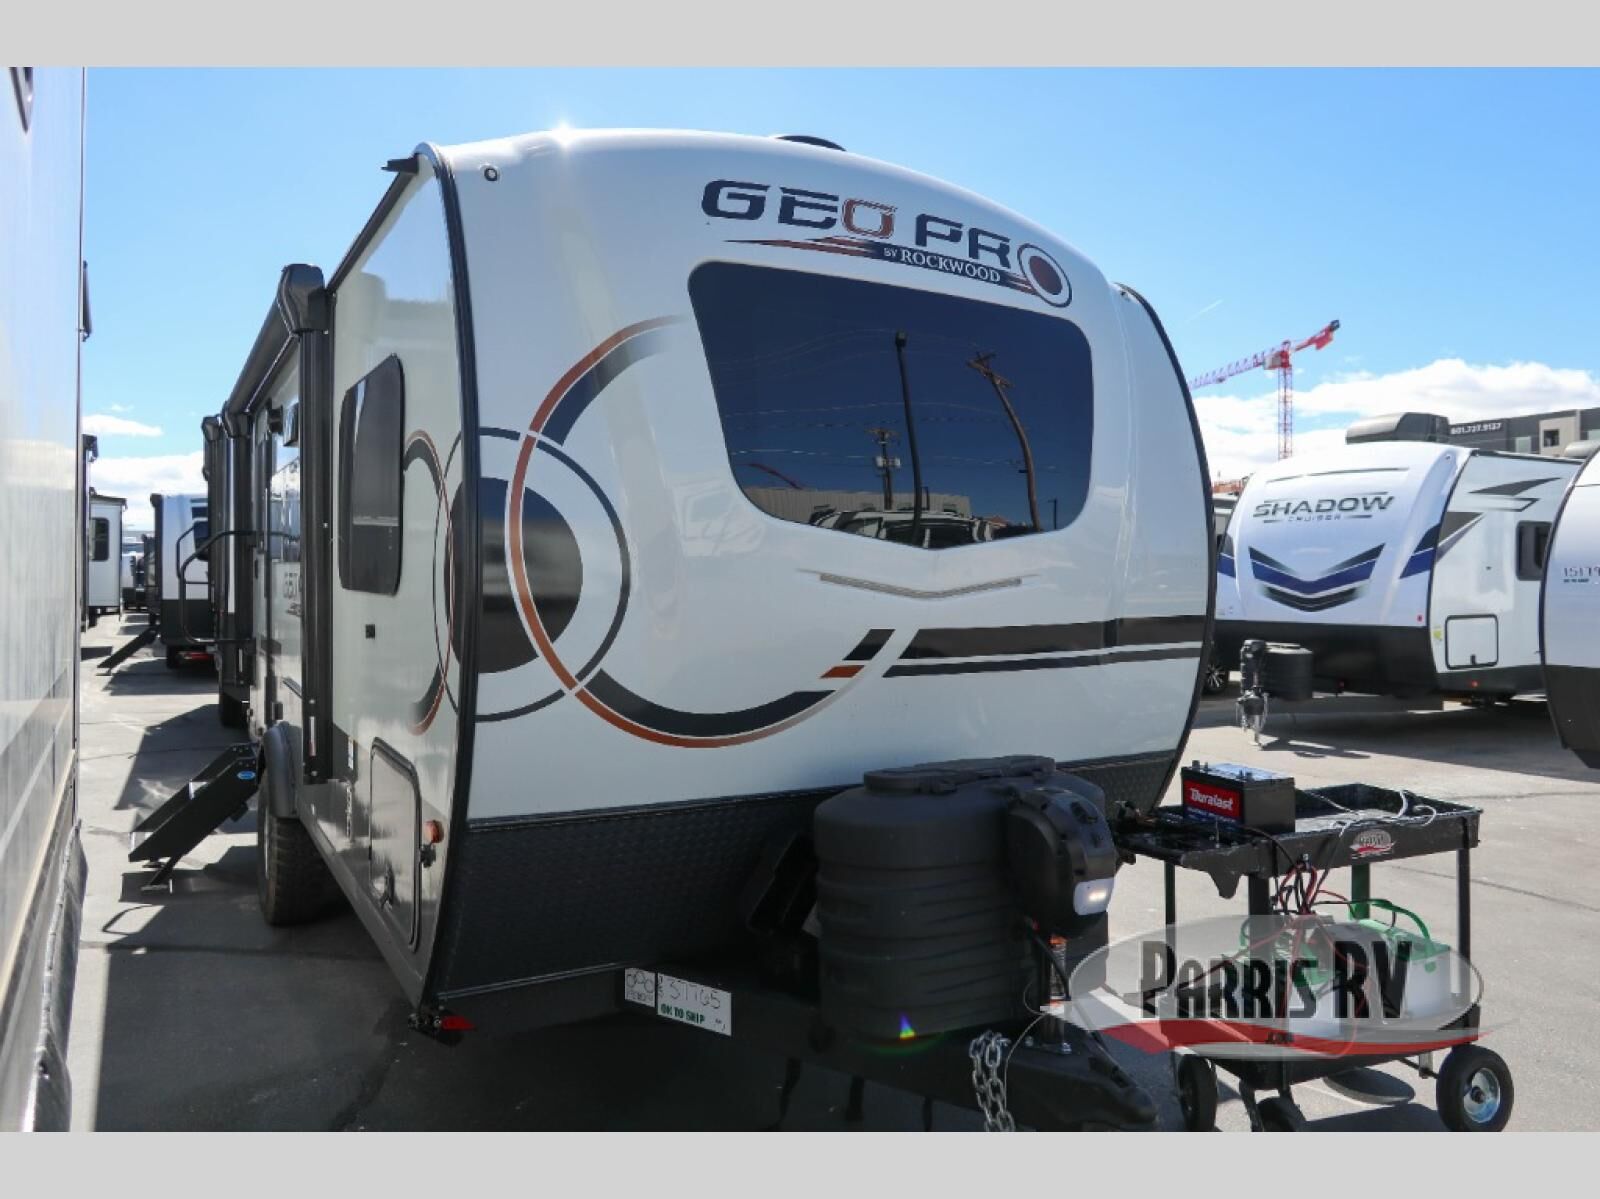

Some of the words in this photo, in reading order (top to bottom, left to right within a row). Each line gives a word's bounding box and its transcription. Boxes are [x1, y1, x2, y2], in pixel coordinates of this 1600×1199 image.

[701, 179, 897, 240] GEO
[883, 247, 898, 257] BY
[900, 249, 1001, 282] ROCKWOOD
[1252, 496, 1395, 518] SHADOW
[1190, 788, 1233, 811] Duralast
[660, 1003, 673, 1016] OK
[674, 1006, 684, 1019] TO
[685, 1010, 705, 1024] SHIP
